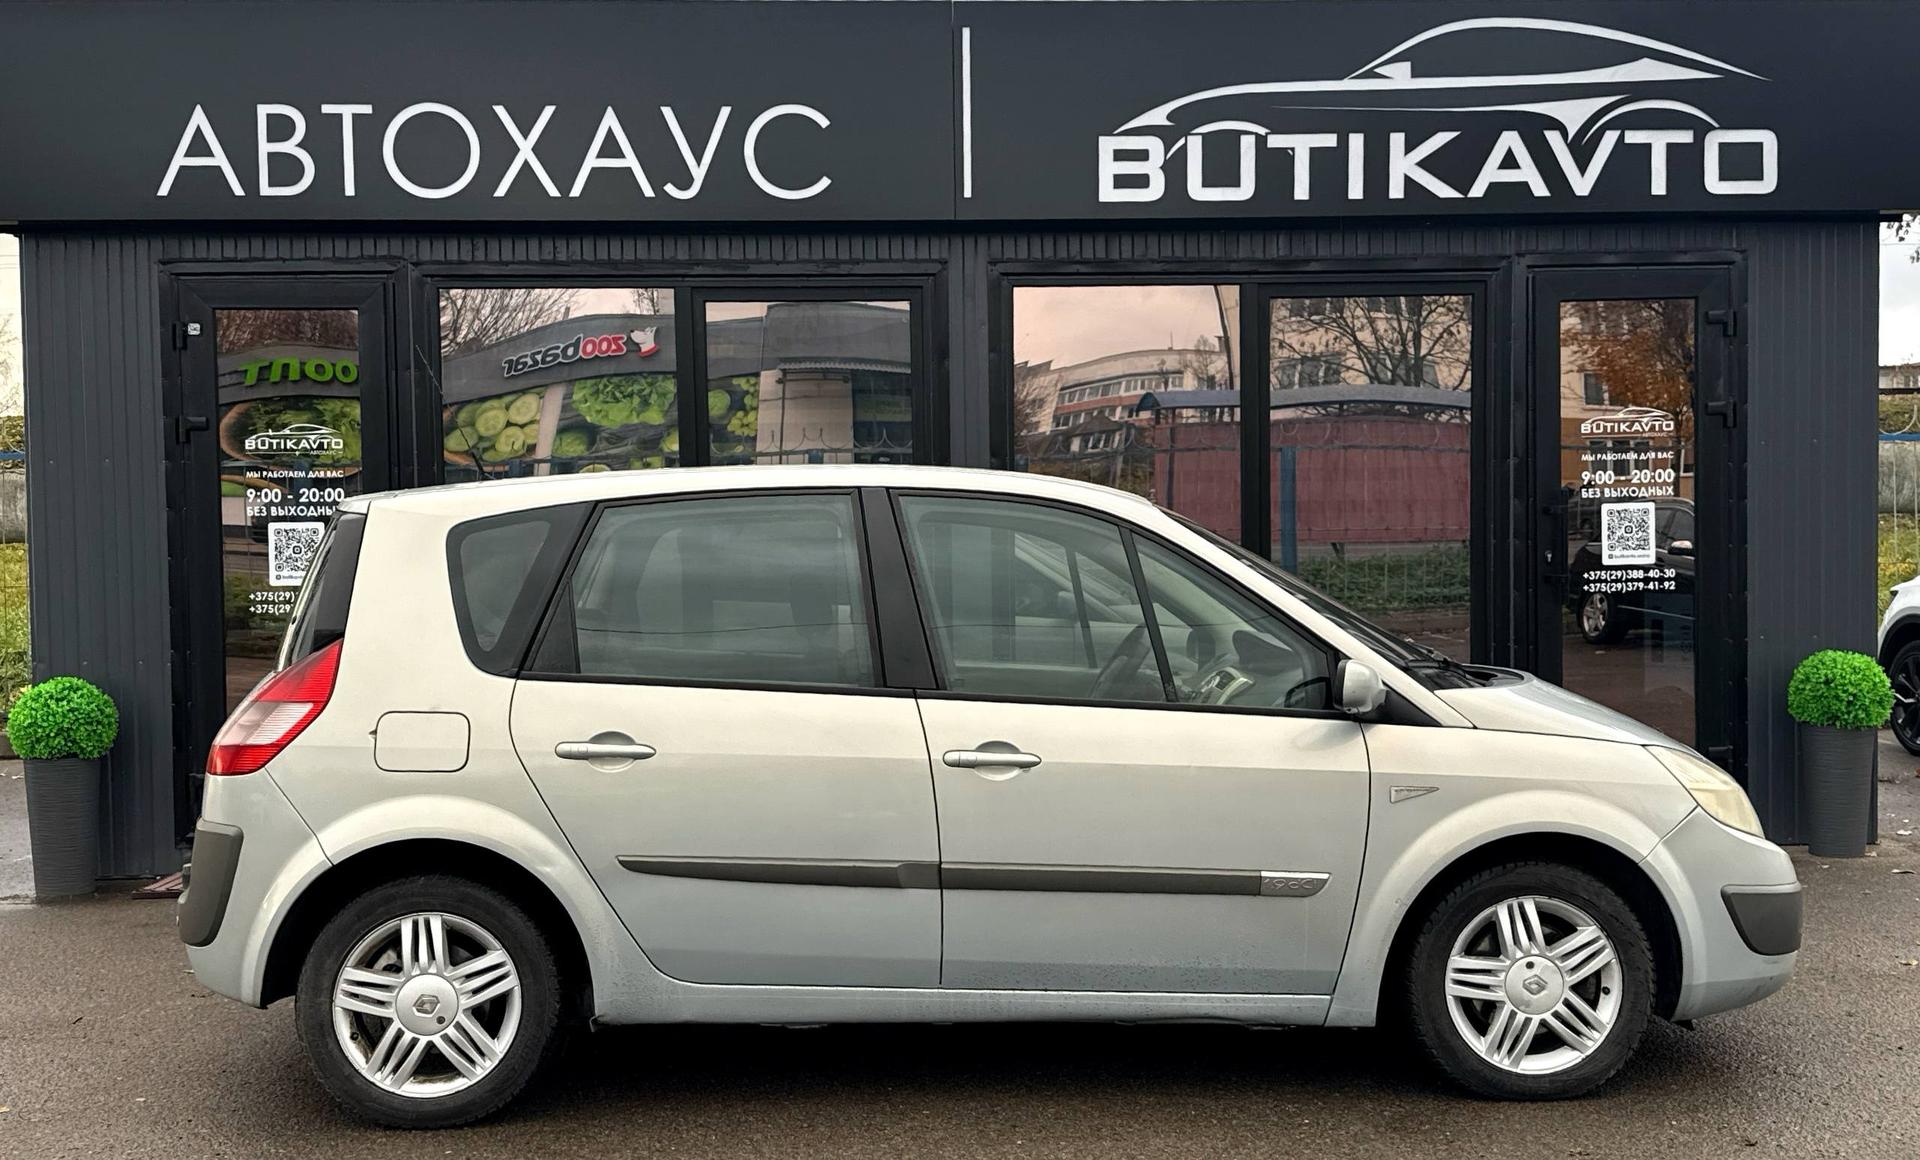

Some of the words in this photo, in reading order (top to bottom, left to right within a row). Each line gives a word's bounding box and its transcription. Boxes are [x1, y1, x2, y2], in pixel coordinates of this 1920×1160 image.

[156, 101, 832, 200] АВТОХАУС
[1098, 128, 1779, 203] BUTIKAVTO
[1581, 420, 1674, 434] BUTIKAVTO
[245, 438, 343, 450] BUTIKAVTO
[1597, 452, 1638, 461] РАБОТАЕМ
[1639, 451, 1657, 460] ДЛЯ
[1657, 451, 1674, 459] ВАС
[262, 470, 306, 478] РАБОТАЕМ
[307, 470, 325, 478] ДЛЯ
[326, 470, 344, 478] ВАС
[1581, 470, 1615, 485] 9:00
[1631, 468, 1675, 483] 20:00
[246, 488, 281, 503] 9:00
[299, 488, 345, 503] 20:00
[1581, 488, 1600, 499] БЕЗ
[1604, 485, 1675, 498] ВЫХОДНЫХ
[246, 506, 267, 517] БЕЗ
[270, 505, 336, 517] ВЫХОДНЫ
[1582, 568, 1676, 581] +375(29)388-40-30
[1582, 581, 1676, 594] +375(29)379-41-92
[249, 591, 298, 603] +375(29)
